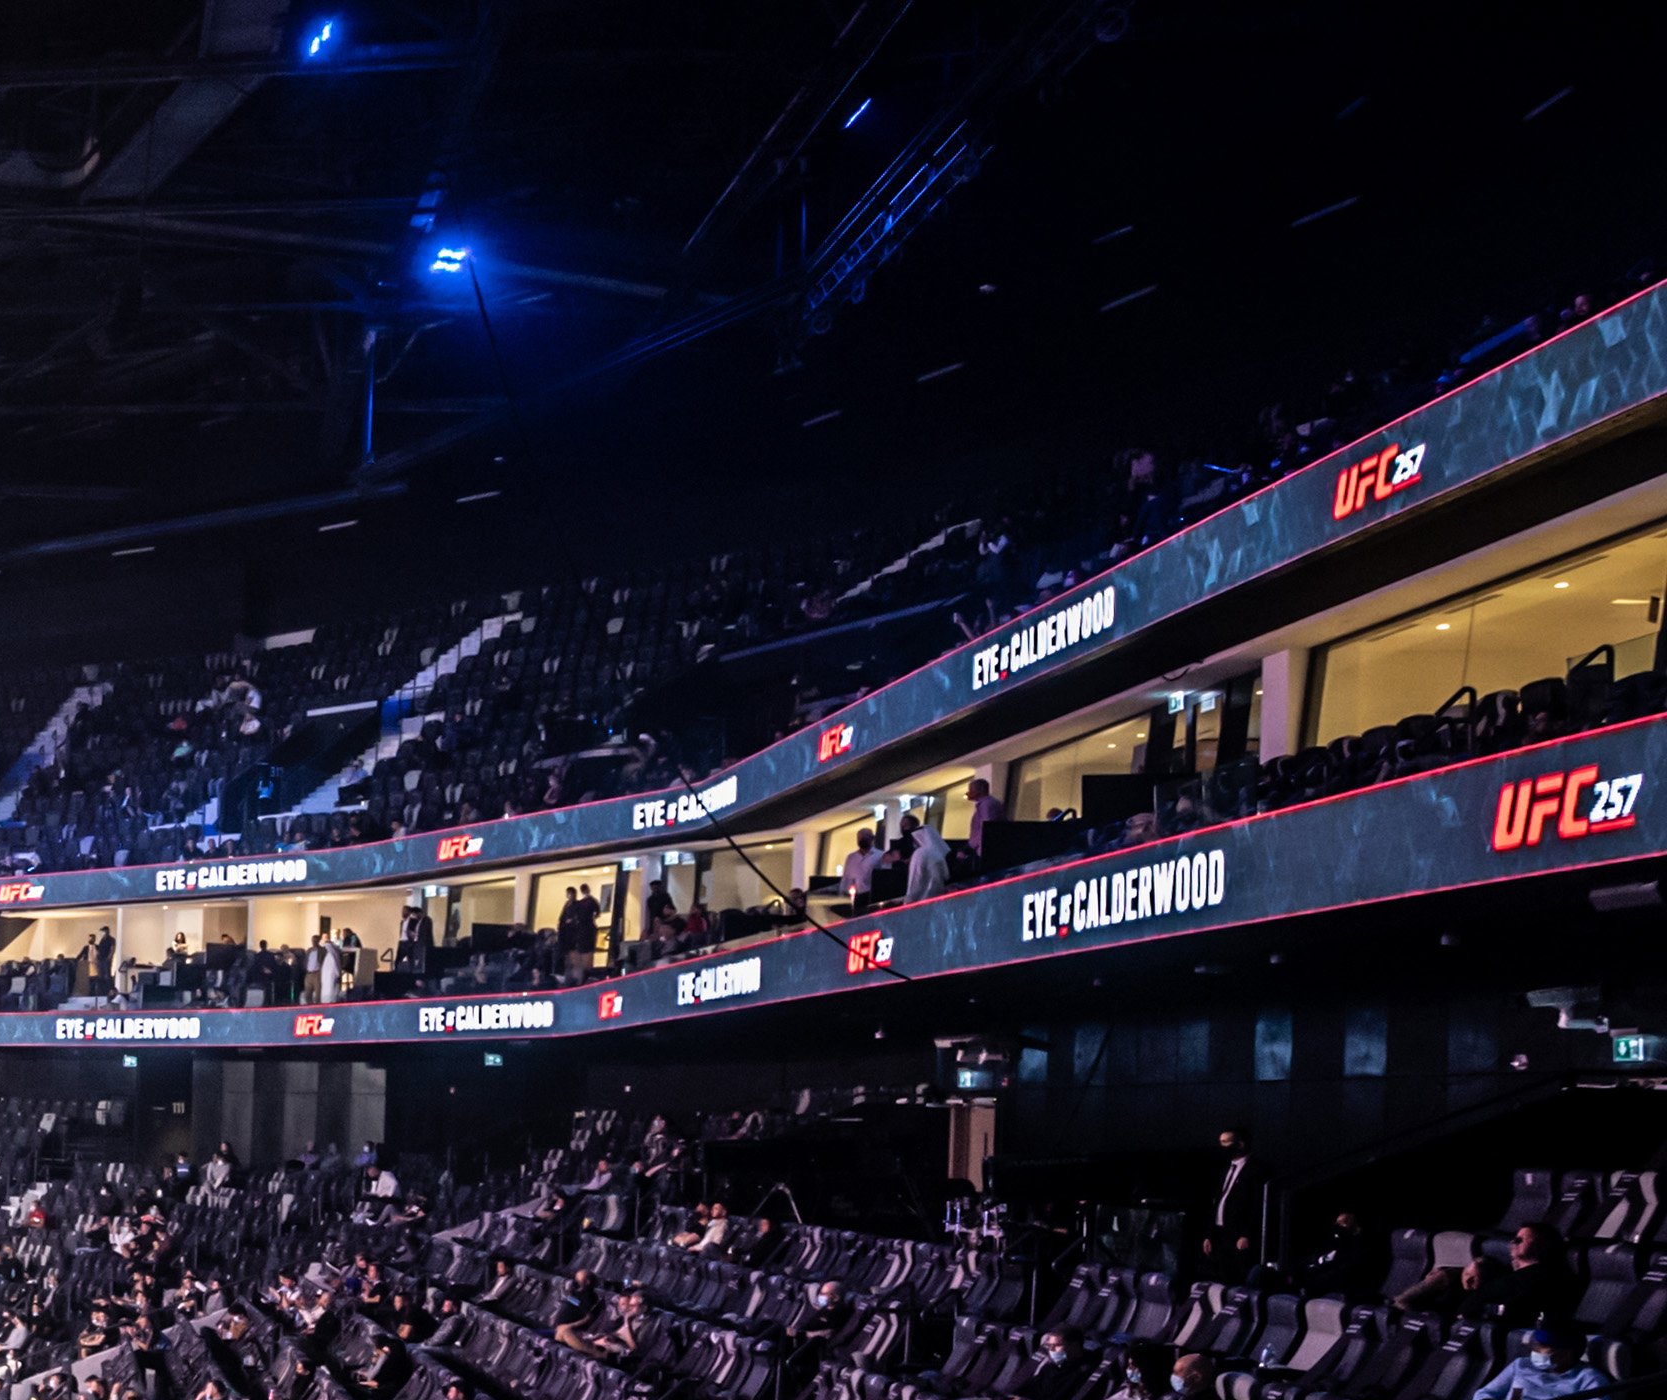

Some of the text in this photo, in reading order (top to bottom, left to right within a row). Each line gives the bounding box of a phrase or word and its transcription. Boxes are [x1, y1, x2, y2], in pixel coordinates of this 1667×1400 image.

[1333, 443, 1400, 520] UFC
[972, 643, 1000, 691] EYE
[1010, 585, 1116, 673] CALDERWOOD
[818, 723, 847, 763] UFC
[633, 800, 666, 831] EYE
[1493, 763, 1644, 852] UFC 257
[437, 836, 470, 862] UFC
[156, 859, 307, 892] EYE CALDERWOOD
[1022, 887, 1058, 943] EYE
[1073, 849, 1226, 933] CALDERWOOD
[56, 1016, 201, 1040] EYE CALDERWOOD
[294, 1013, 324, 1039] UFC
[419, 1001, 554, 1033] EYE CALDERWOOD
